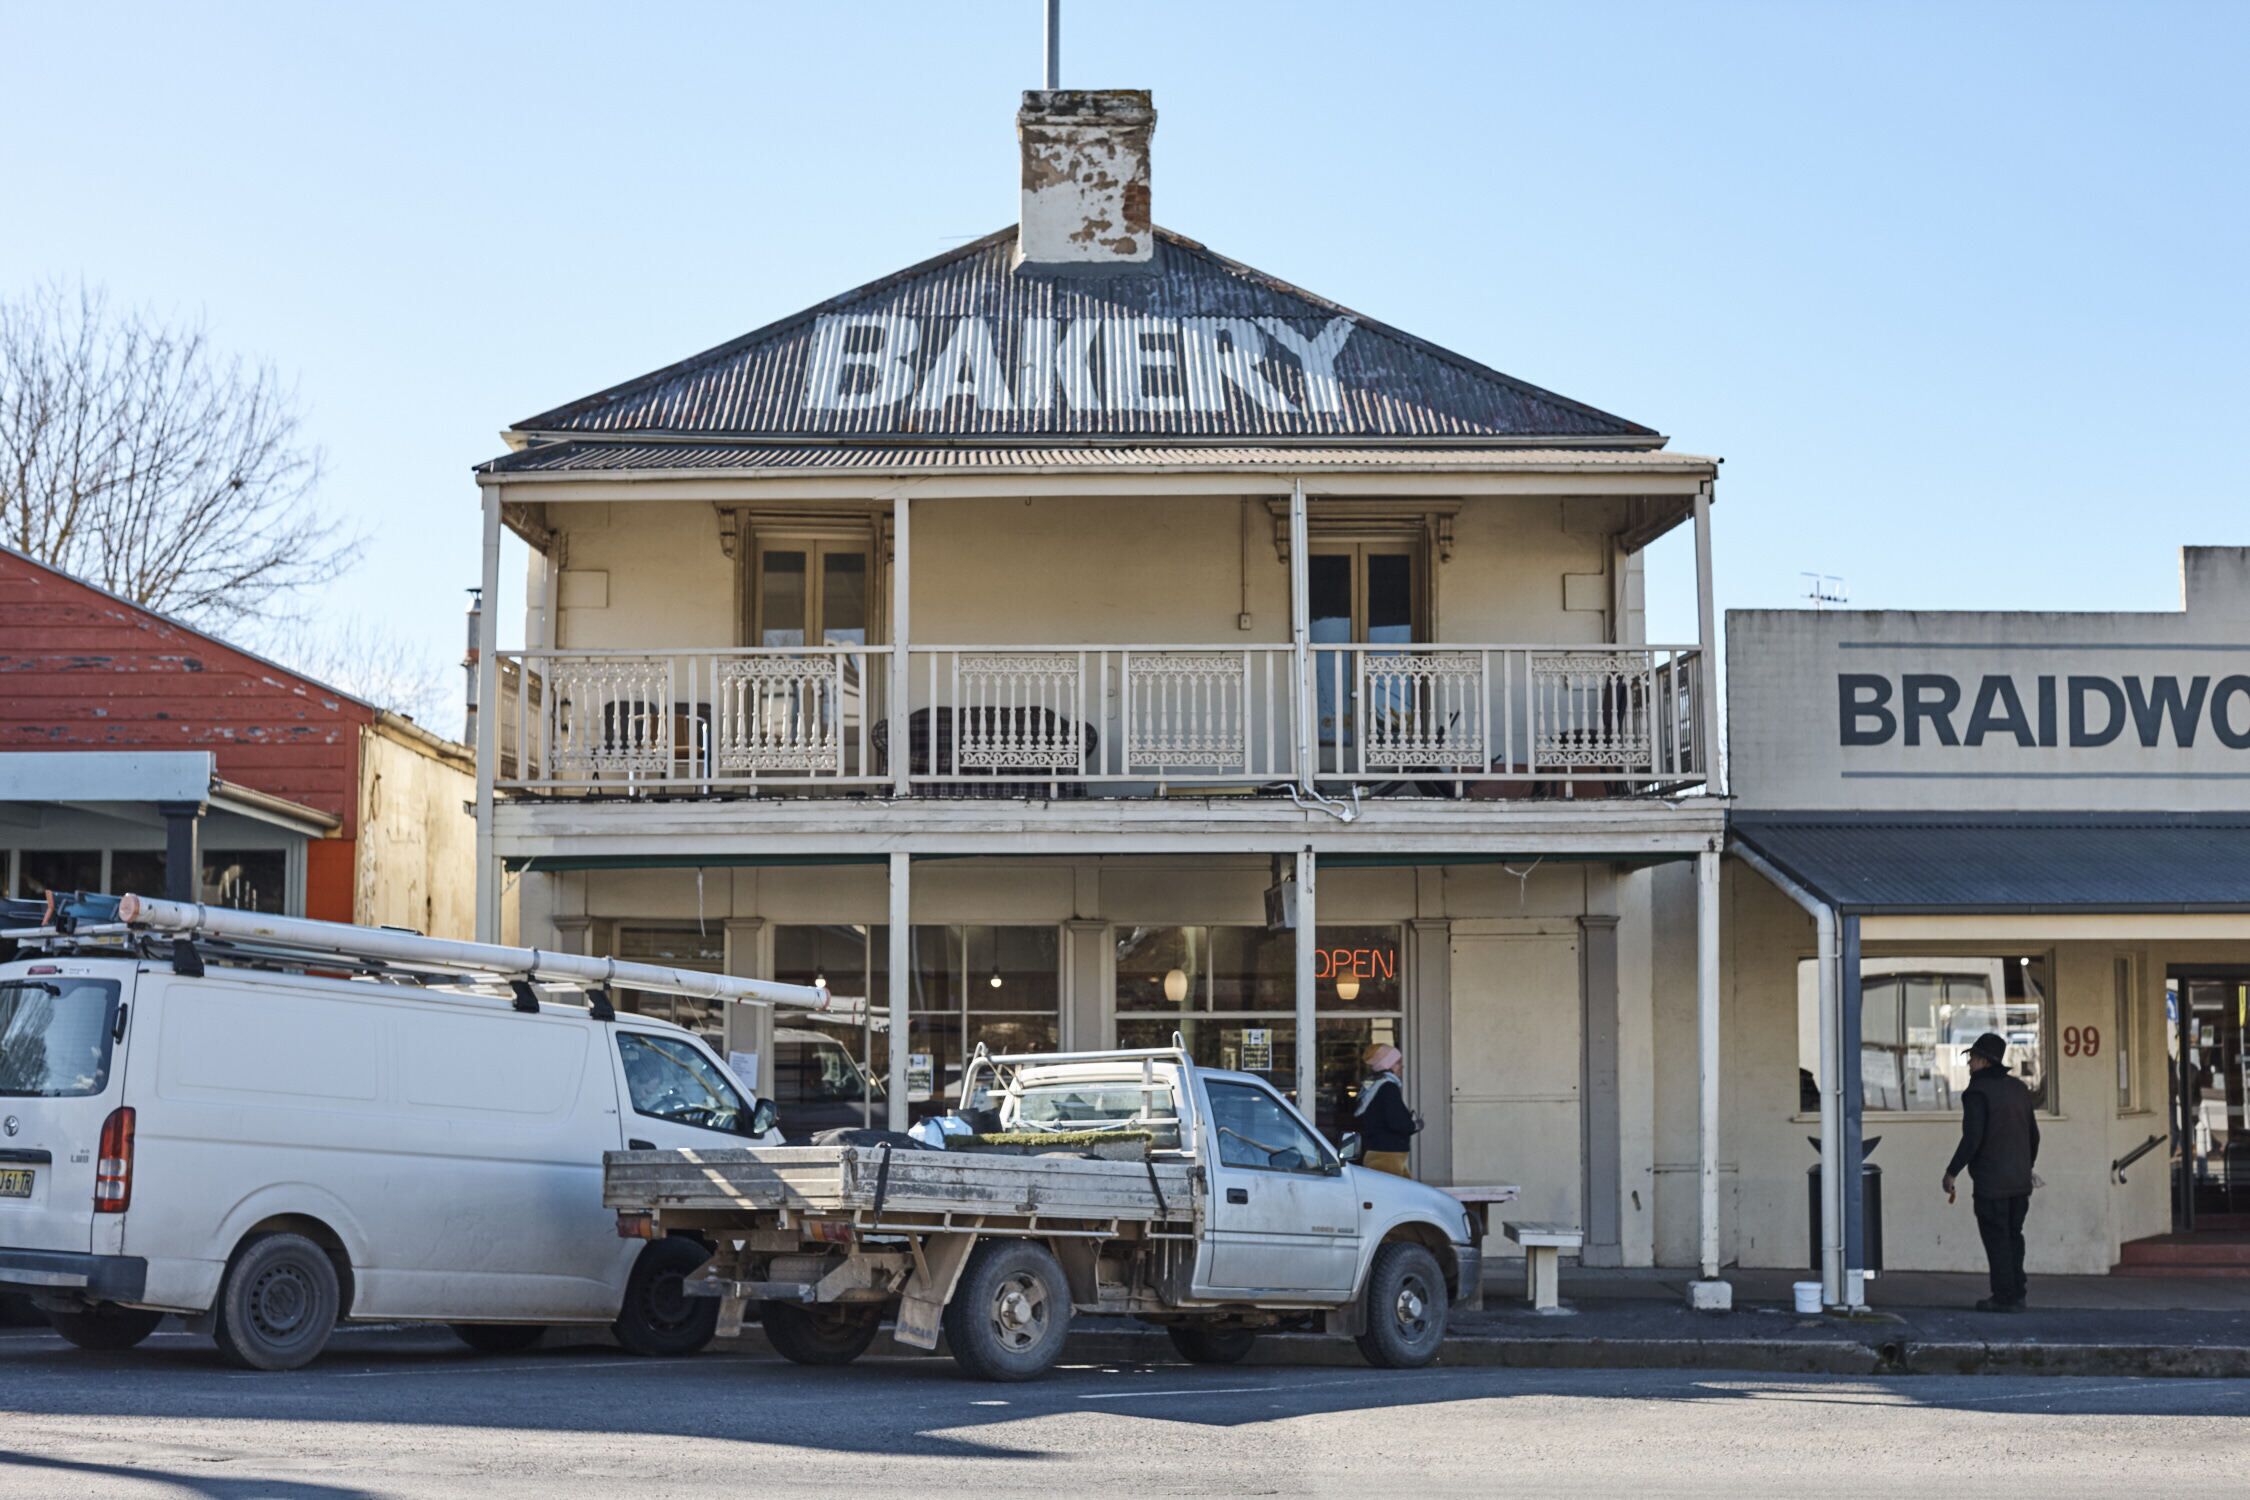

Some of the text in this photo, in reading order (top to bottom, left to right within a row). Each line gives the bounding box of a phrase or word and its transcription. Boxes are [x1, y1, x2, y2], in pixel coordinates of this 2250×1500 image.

[802, 313, 1357, 414] BAKERY
[1838, 673, 2250, 749] BRAIDWO
[1314, 948, 1394, 978] OPEN
[2063, 1025, 2100, 1057] 99
